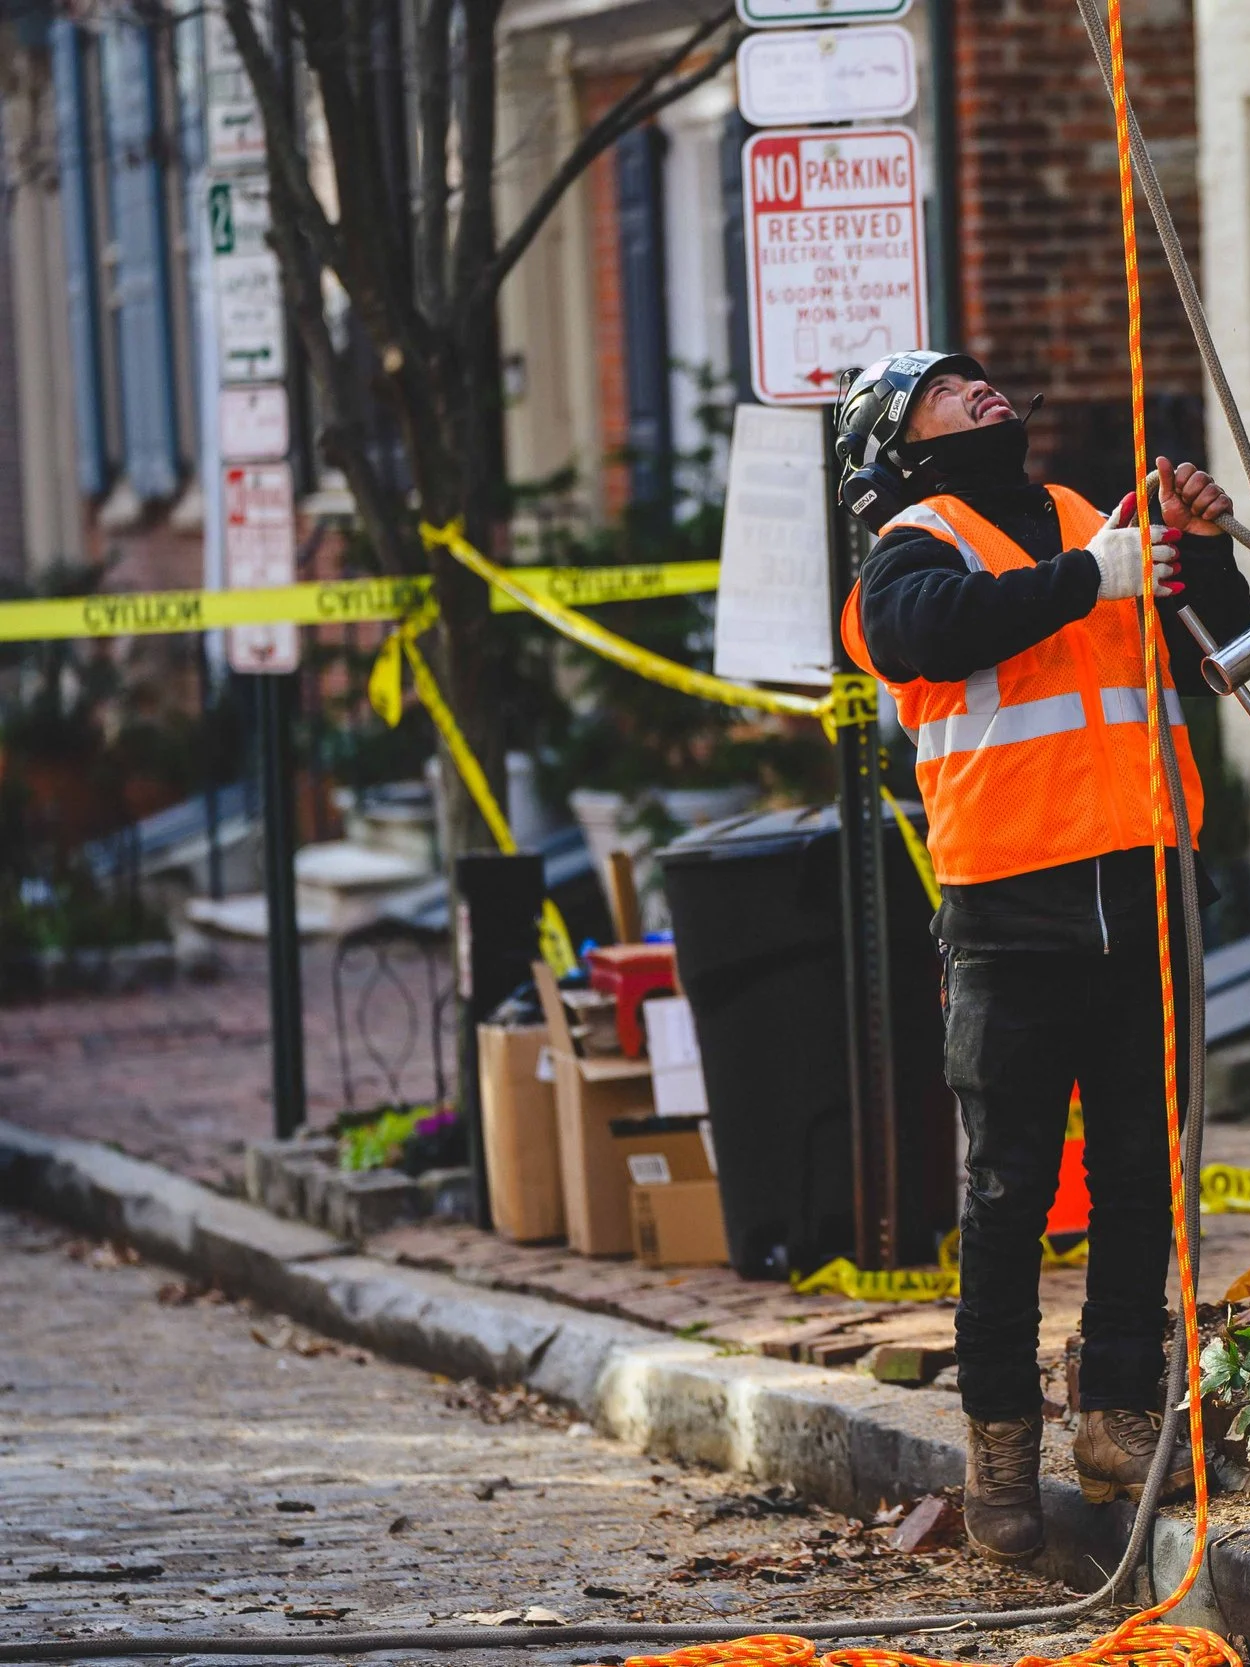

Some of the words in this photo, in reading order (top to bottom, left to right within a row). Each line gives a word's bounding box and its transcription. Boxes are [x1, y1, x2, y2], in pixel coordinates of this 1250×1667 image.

[754, 152, 797, 203] NO
[805, 156, 907, 192] PARKING
[768, 212, 902, 243] RESERVED
[761, 245, 834, 265] ELECTRIC
[844, 241, 909, 261] VEHICLE
[814, 264, 859, 283] ONLY
[796, 304, 881, 324] MON-SUN
[853, 493, 876, 512] SENA
